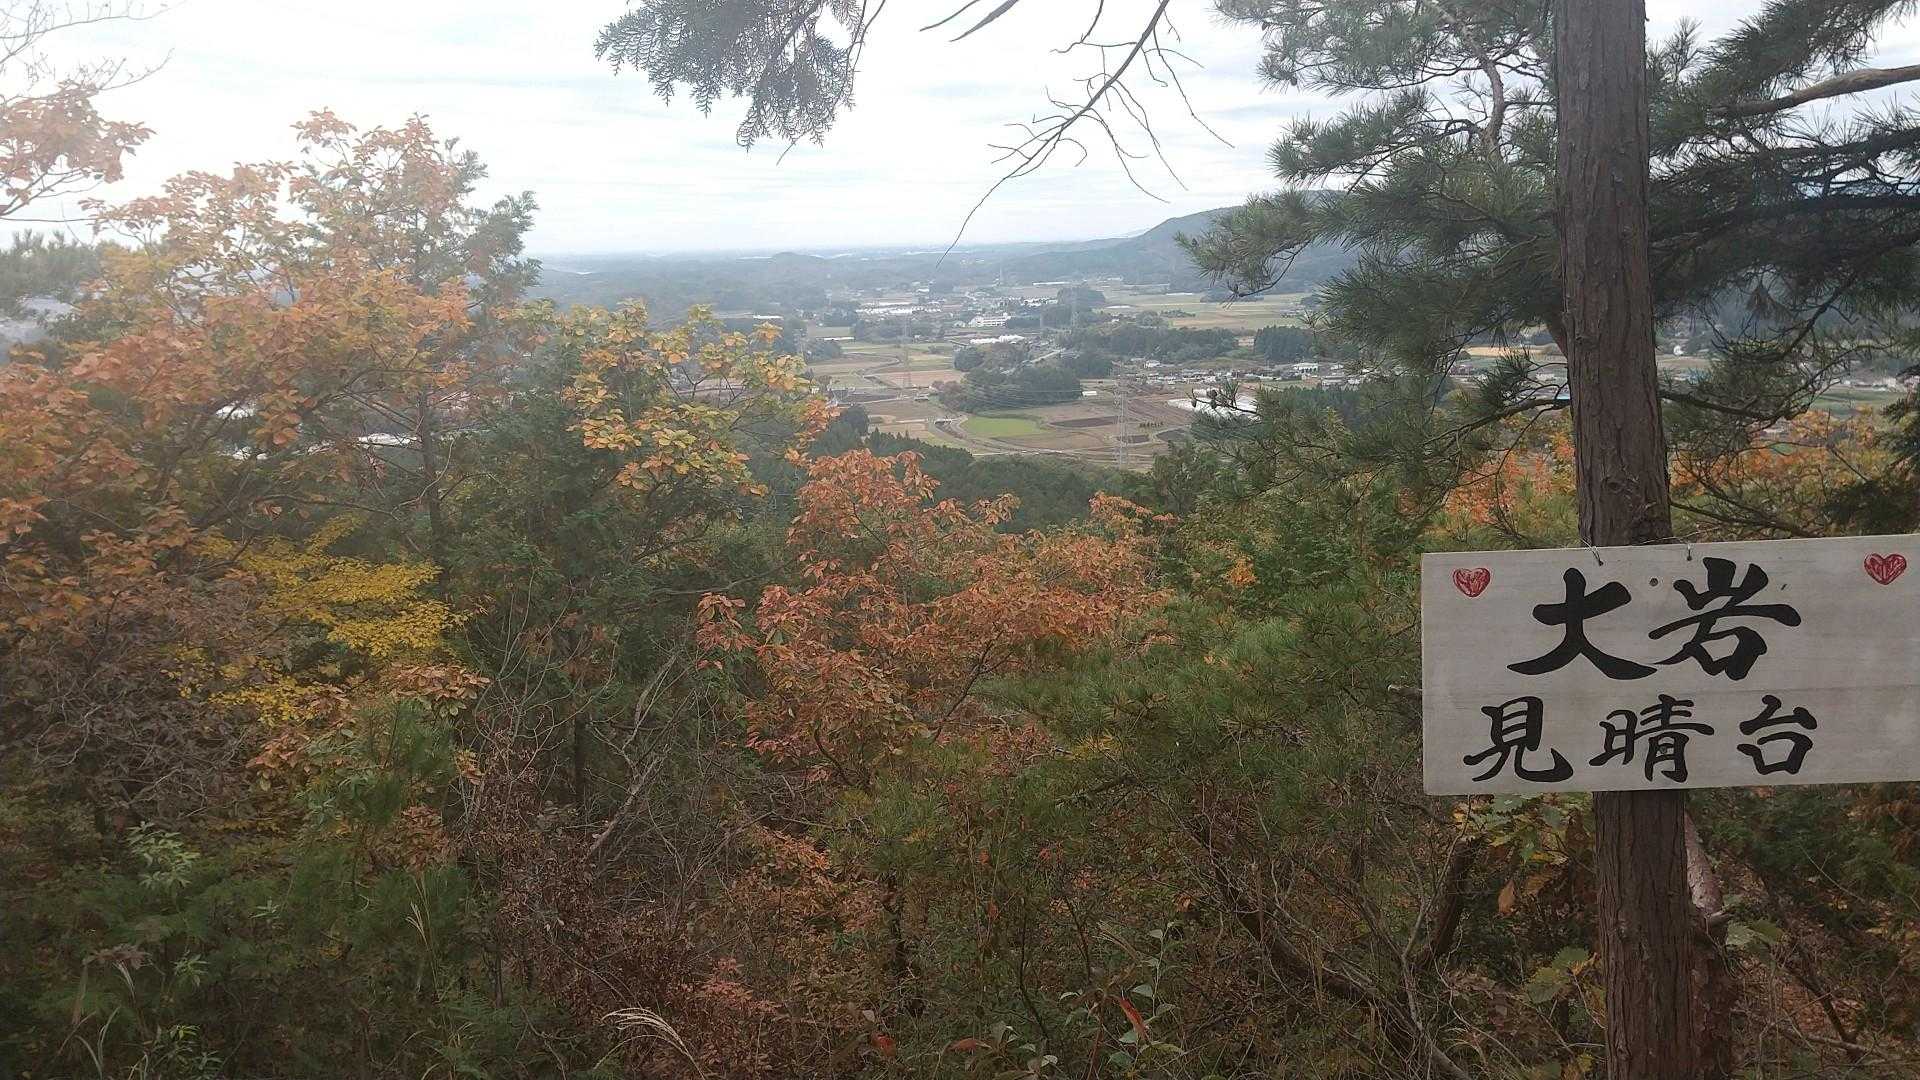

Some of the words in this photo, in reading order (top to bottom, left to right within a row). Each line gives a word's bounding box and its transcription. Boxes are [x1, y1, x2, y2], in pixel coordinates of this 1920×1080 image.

[1506, 556, 1802, 681] 大岩
[1463, 694, 1818, 783] 見晴台
